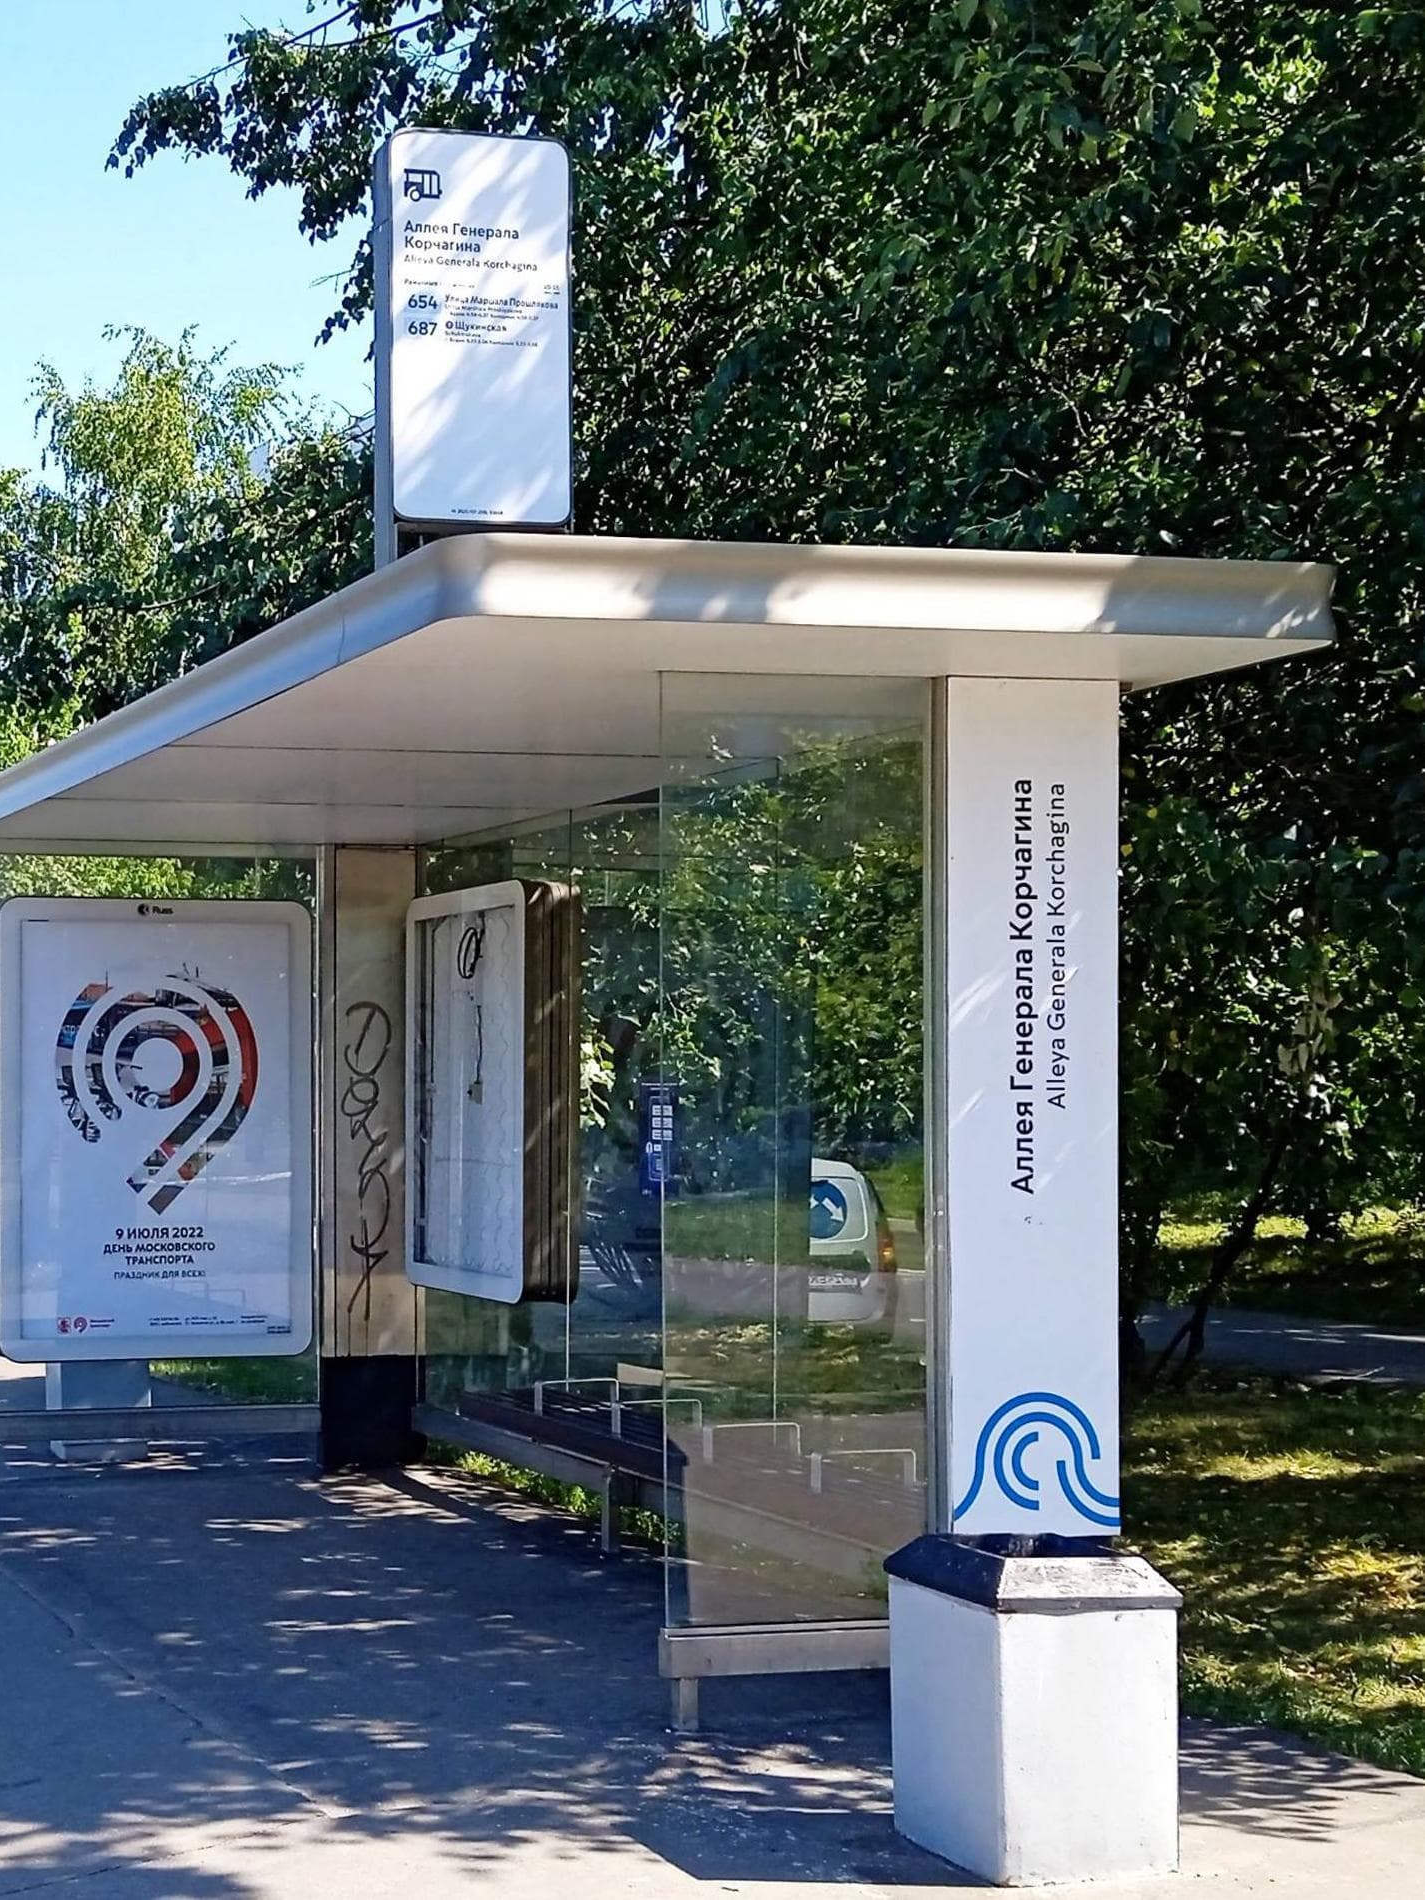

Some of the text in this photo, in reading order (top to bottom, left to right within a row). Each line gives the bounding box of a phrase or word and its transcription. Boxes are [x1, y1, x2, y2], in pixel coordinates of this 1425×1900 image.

[404, 219, 519, 240] Аллея Генерала
[404, 235, 481, 253] Корчагина
[408, 294, 437, 310] 654
[408, 321, 438, 336] 687
[1045, 783, 1070, 1110] Alleya Generala Korchagina
[1008, 779, 1039, 1195] Аллея Генерала Корчагина
[115, 1226, 204, 1240] 9 ИЮЛЯ 2022
[103, 1241, 216, 1255] ДЕНЬ МОСКОВСКОГО
[125, 1254, 194, 1266] ТРАНСПОРТА
[114, 1271, 160, 1280] ПРАЗДНИК
[162, 1270, 179, 1280] ДЛЯ
